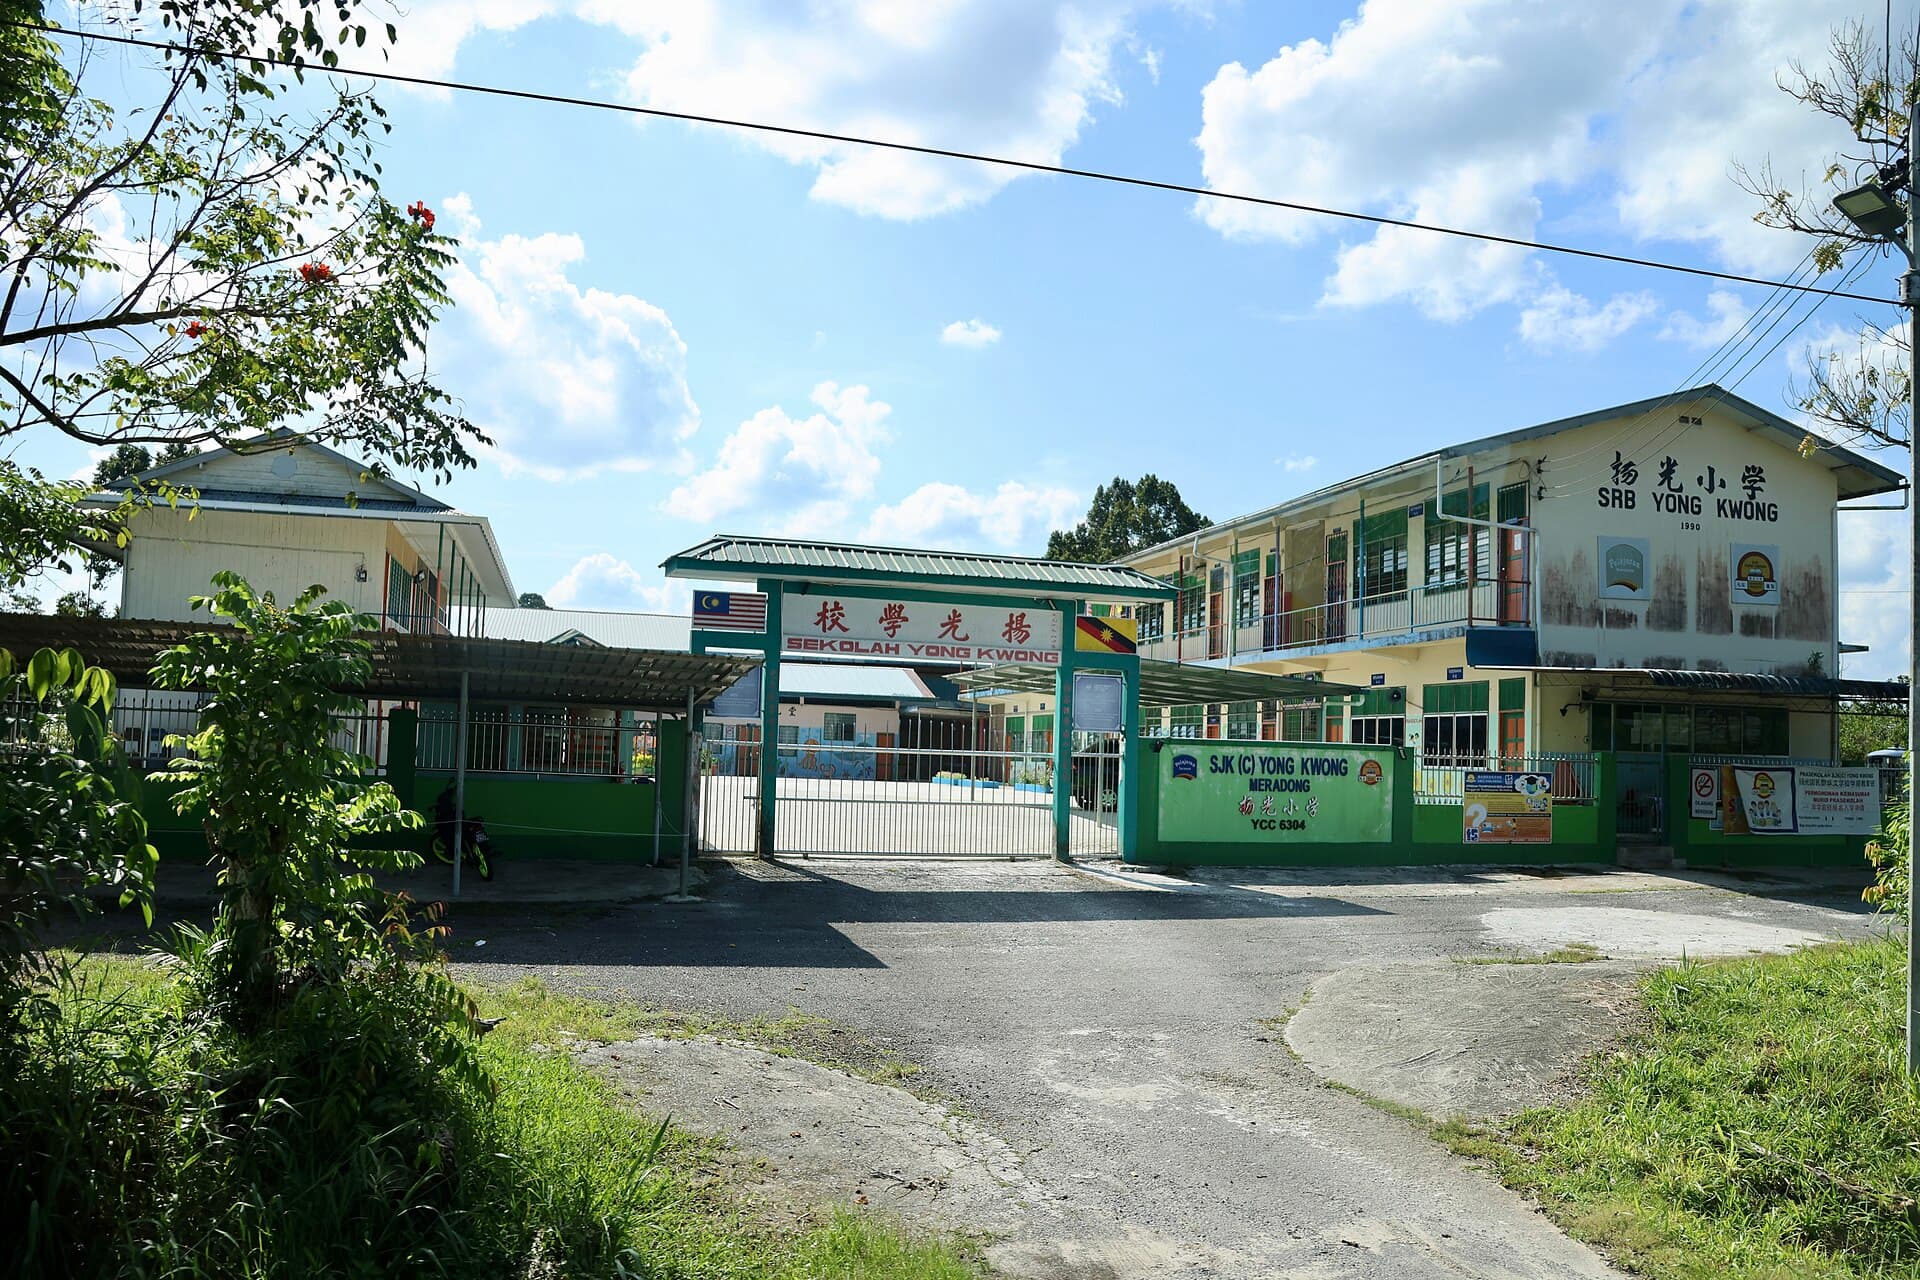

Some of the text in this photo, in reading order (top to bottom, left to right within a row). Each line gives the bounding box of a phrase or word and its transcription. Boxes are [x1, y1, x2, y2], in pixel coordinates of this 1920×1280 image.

[1598, 486, 1779, 523] SRB YONG KWONG
[1681, 522, 1701, 531] 1990
[786, 637, 1059, 664] SEKOLAH YONG KWONG
[1209, 754, 1349, 777] SJK (C) YONG KWONG
[1249, 778, 1311, 793] MERADONG
[1251, 818, 1305, 831] YCC 6304
